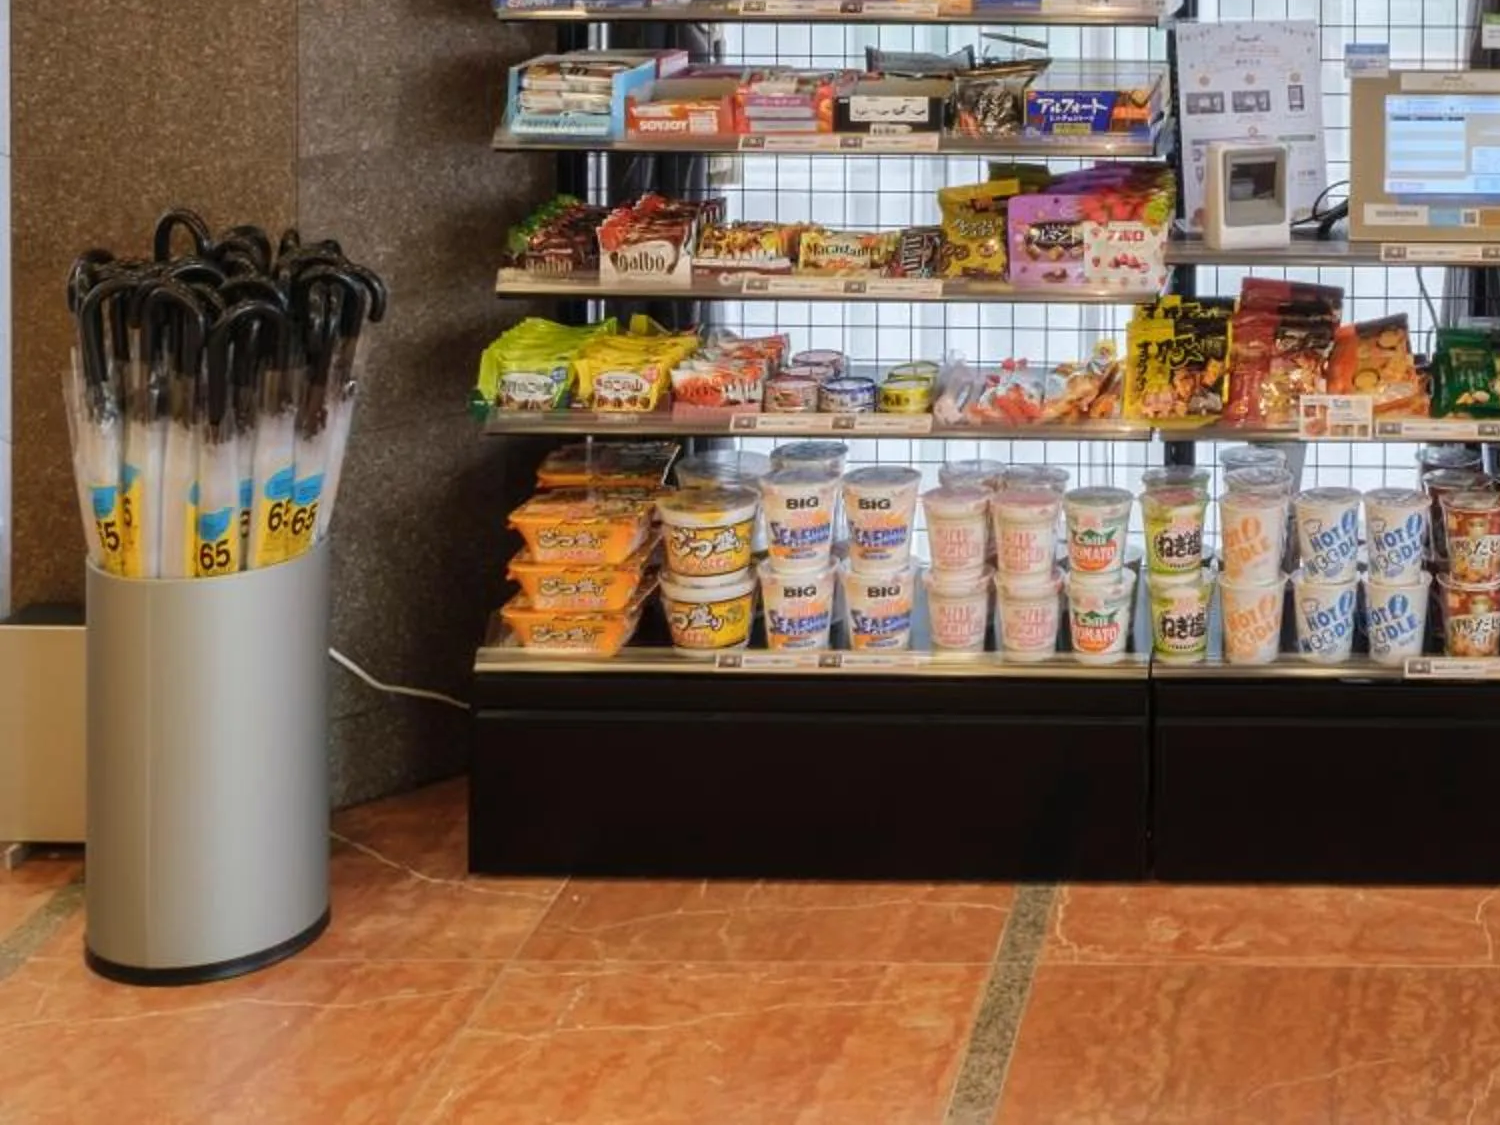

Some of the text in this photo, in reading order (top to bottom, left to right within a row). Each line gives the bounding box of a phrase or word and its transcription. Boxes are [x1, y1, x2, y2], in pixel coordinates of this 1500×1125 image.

[1036, 97, 1108, 114] アルフォート
[638, 119, 690, 132] SOYJOY
[785, 496, 819, 511] BIG
[858, 498, 891, 511] BIG
[1157, 529, 1201, 559] ねぎ塩
[1310, 526, 1344, 552] HOT
[200, 539, 231, 570] 65
[783, 585, 817, 599] BIG
[866, 585, 901, 599] BIG
[1307, 605, 1341, 630] HOT
[1161, 612, 1205, 642] ねぎ塩
